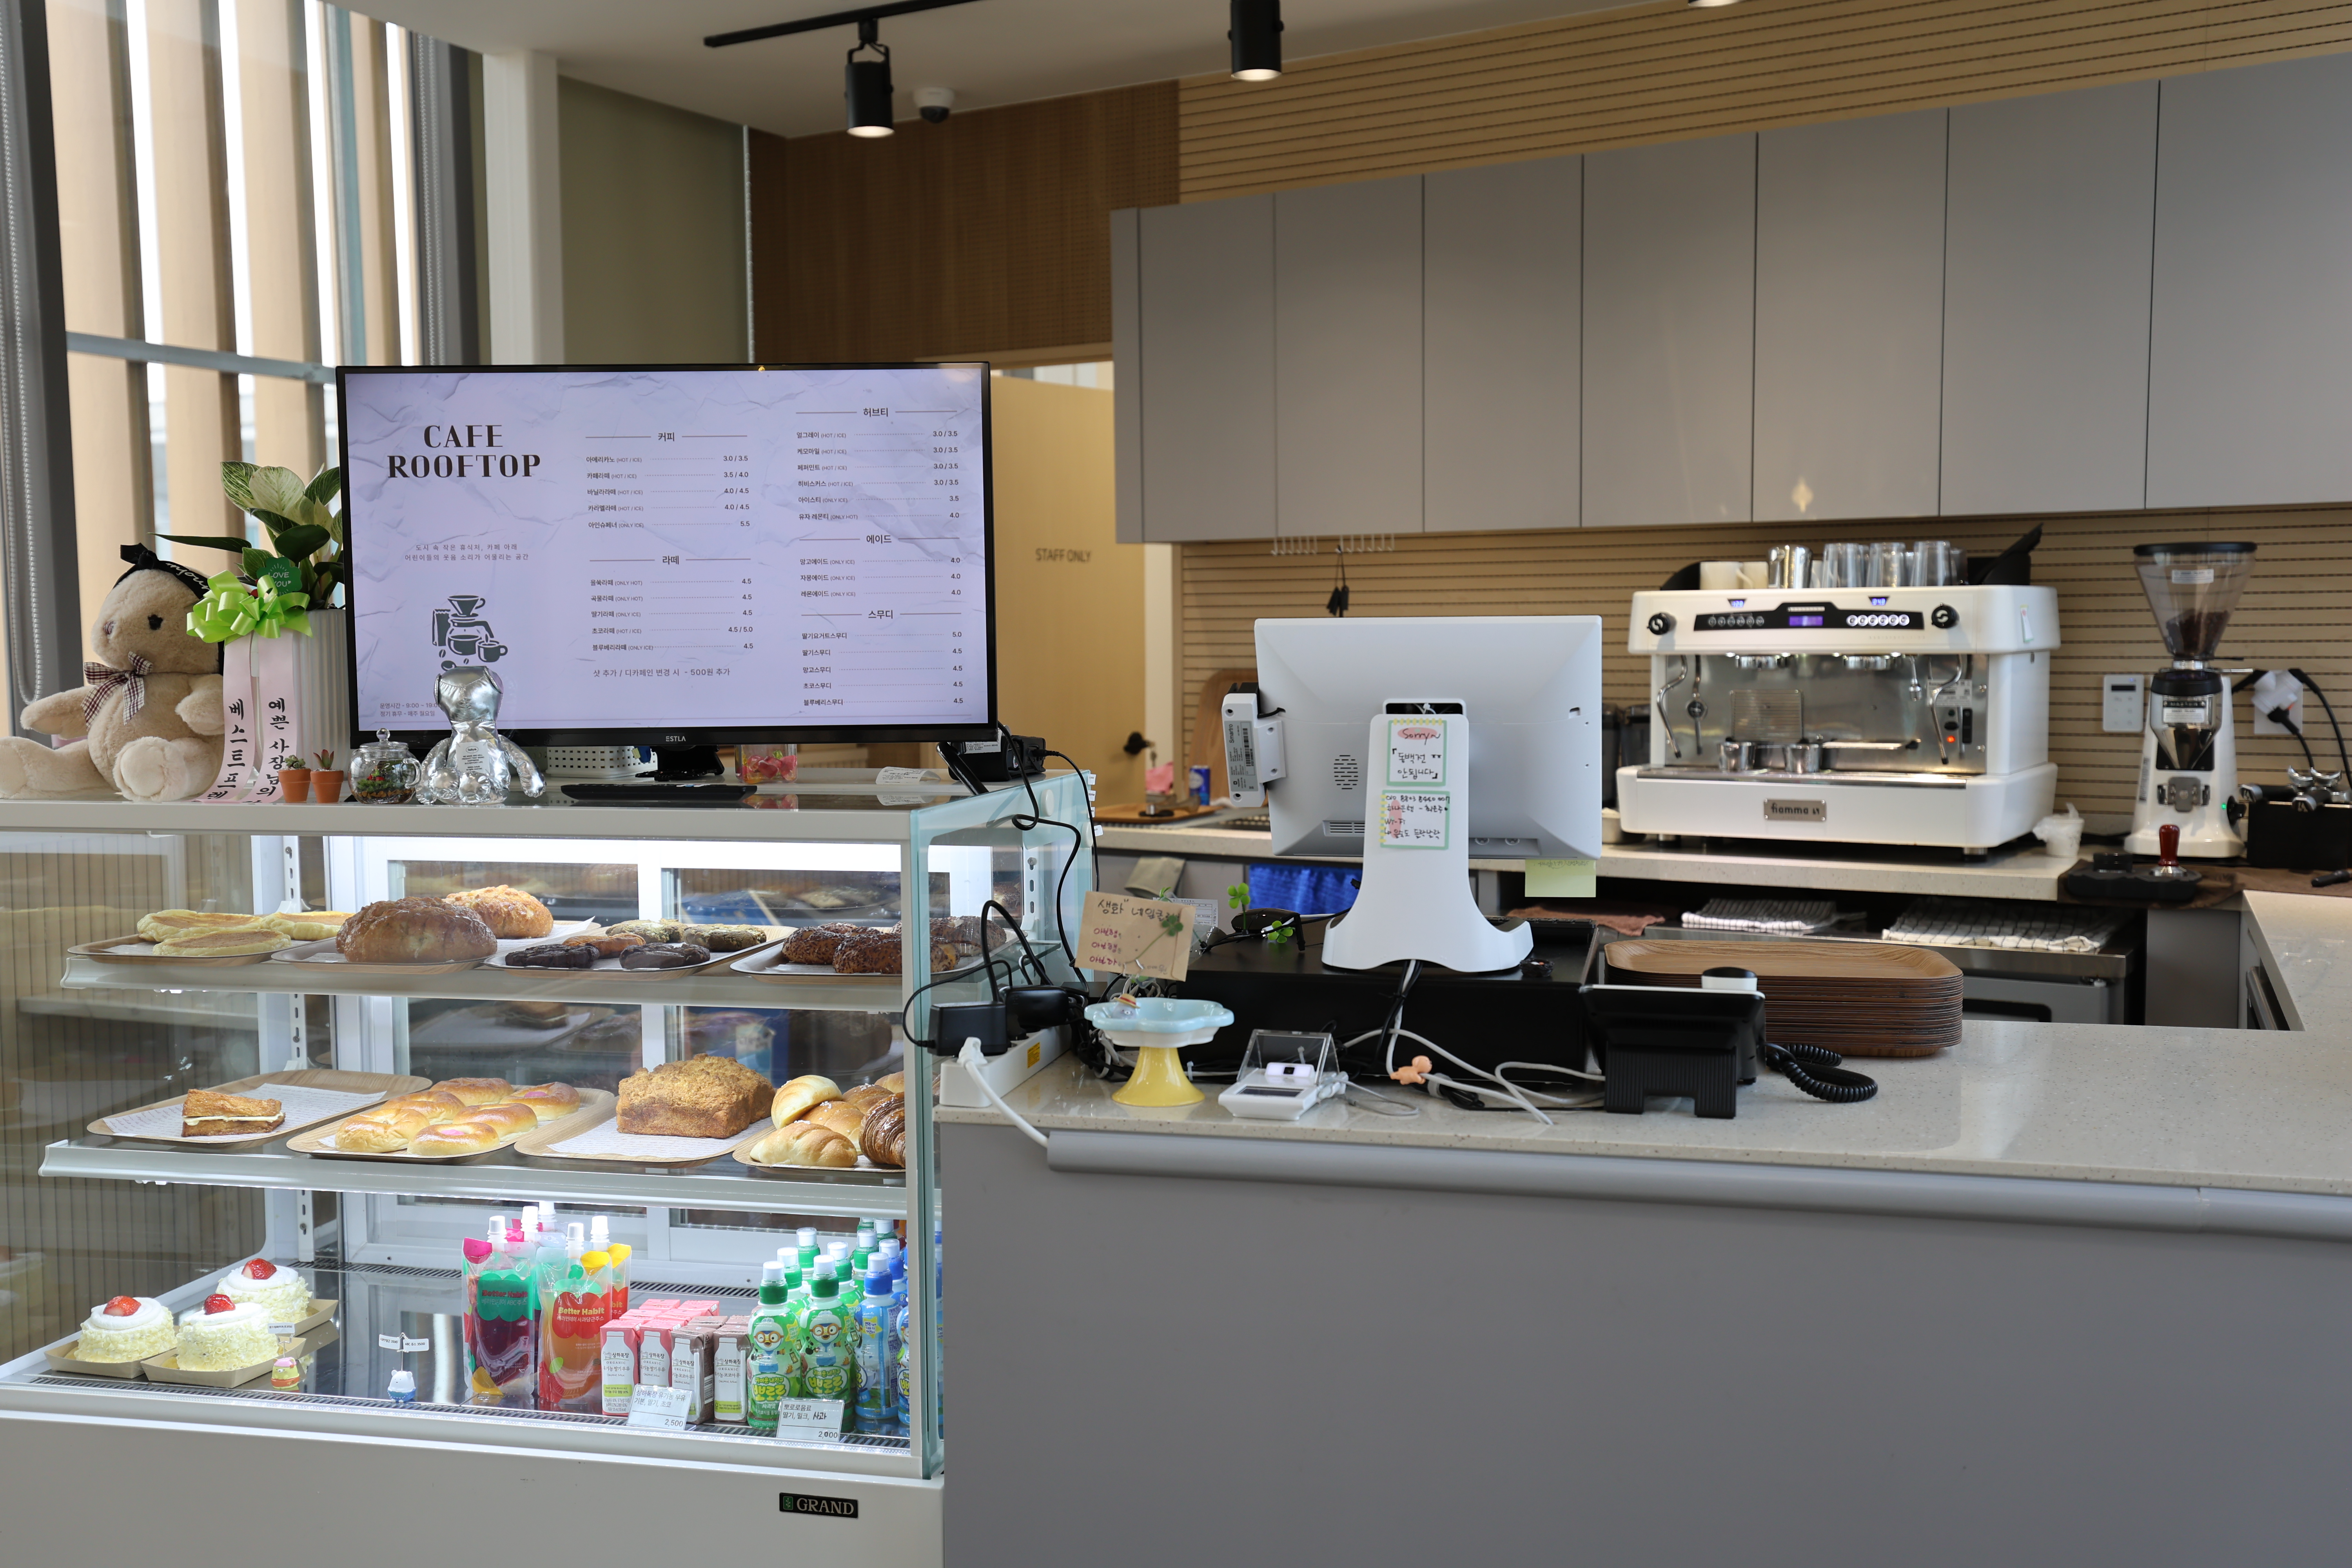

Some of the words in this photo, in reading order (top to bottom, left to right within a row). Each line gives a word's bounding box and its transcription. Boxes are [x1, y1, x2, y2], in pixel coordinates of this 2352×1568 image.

[864, 408, 888, 417] 허브티
[424, 425, 503, 448] CAFE
[658, 432, 674, 441] 커피
[387, 455, 540, 478] ROOFTOP
[866, 535, 891, 544] 에이드
[663, 555, 679, 564] 라떼
[1035, 548, 1065, 561] STAFF
[1067, 549, 1091, 563] ONLY
[868, 610, 893, 619] 스무디
[268, 697, 289, 730] 예쁜
[207, 698, 248, 799] 베스트프렌
[1771, 802, 1809, 815] fiamma
[557, 1307, 581, 1315] Better
[808, 1375, 844, 1394] 뽀로로
[636, 1389, 657, 1397] 상하목장
[658, 1391, 674, 1400] 유기농
[753, 1384, 787, 1402] 뽀로로
[634, 1397, 646, 1406] 기본,
[648, 1399, 659, 1407] 딸기,
[813, 1411, 827, 1420] 사과
[664, 1419, 683, 1427] 2,500
[796, 1497, 854, 1515] GRAND
